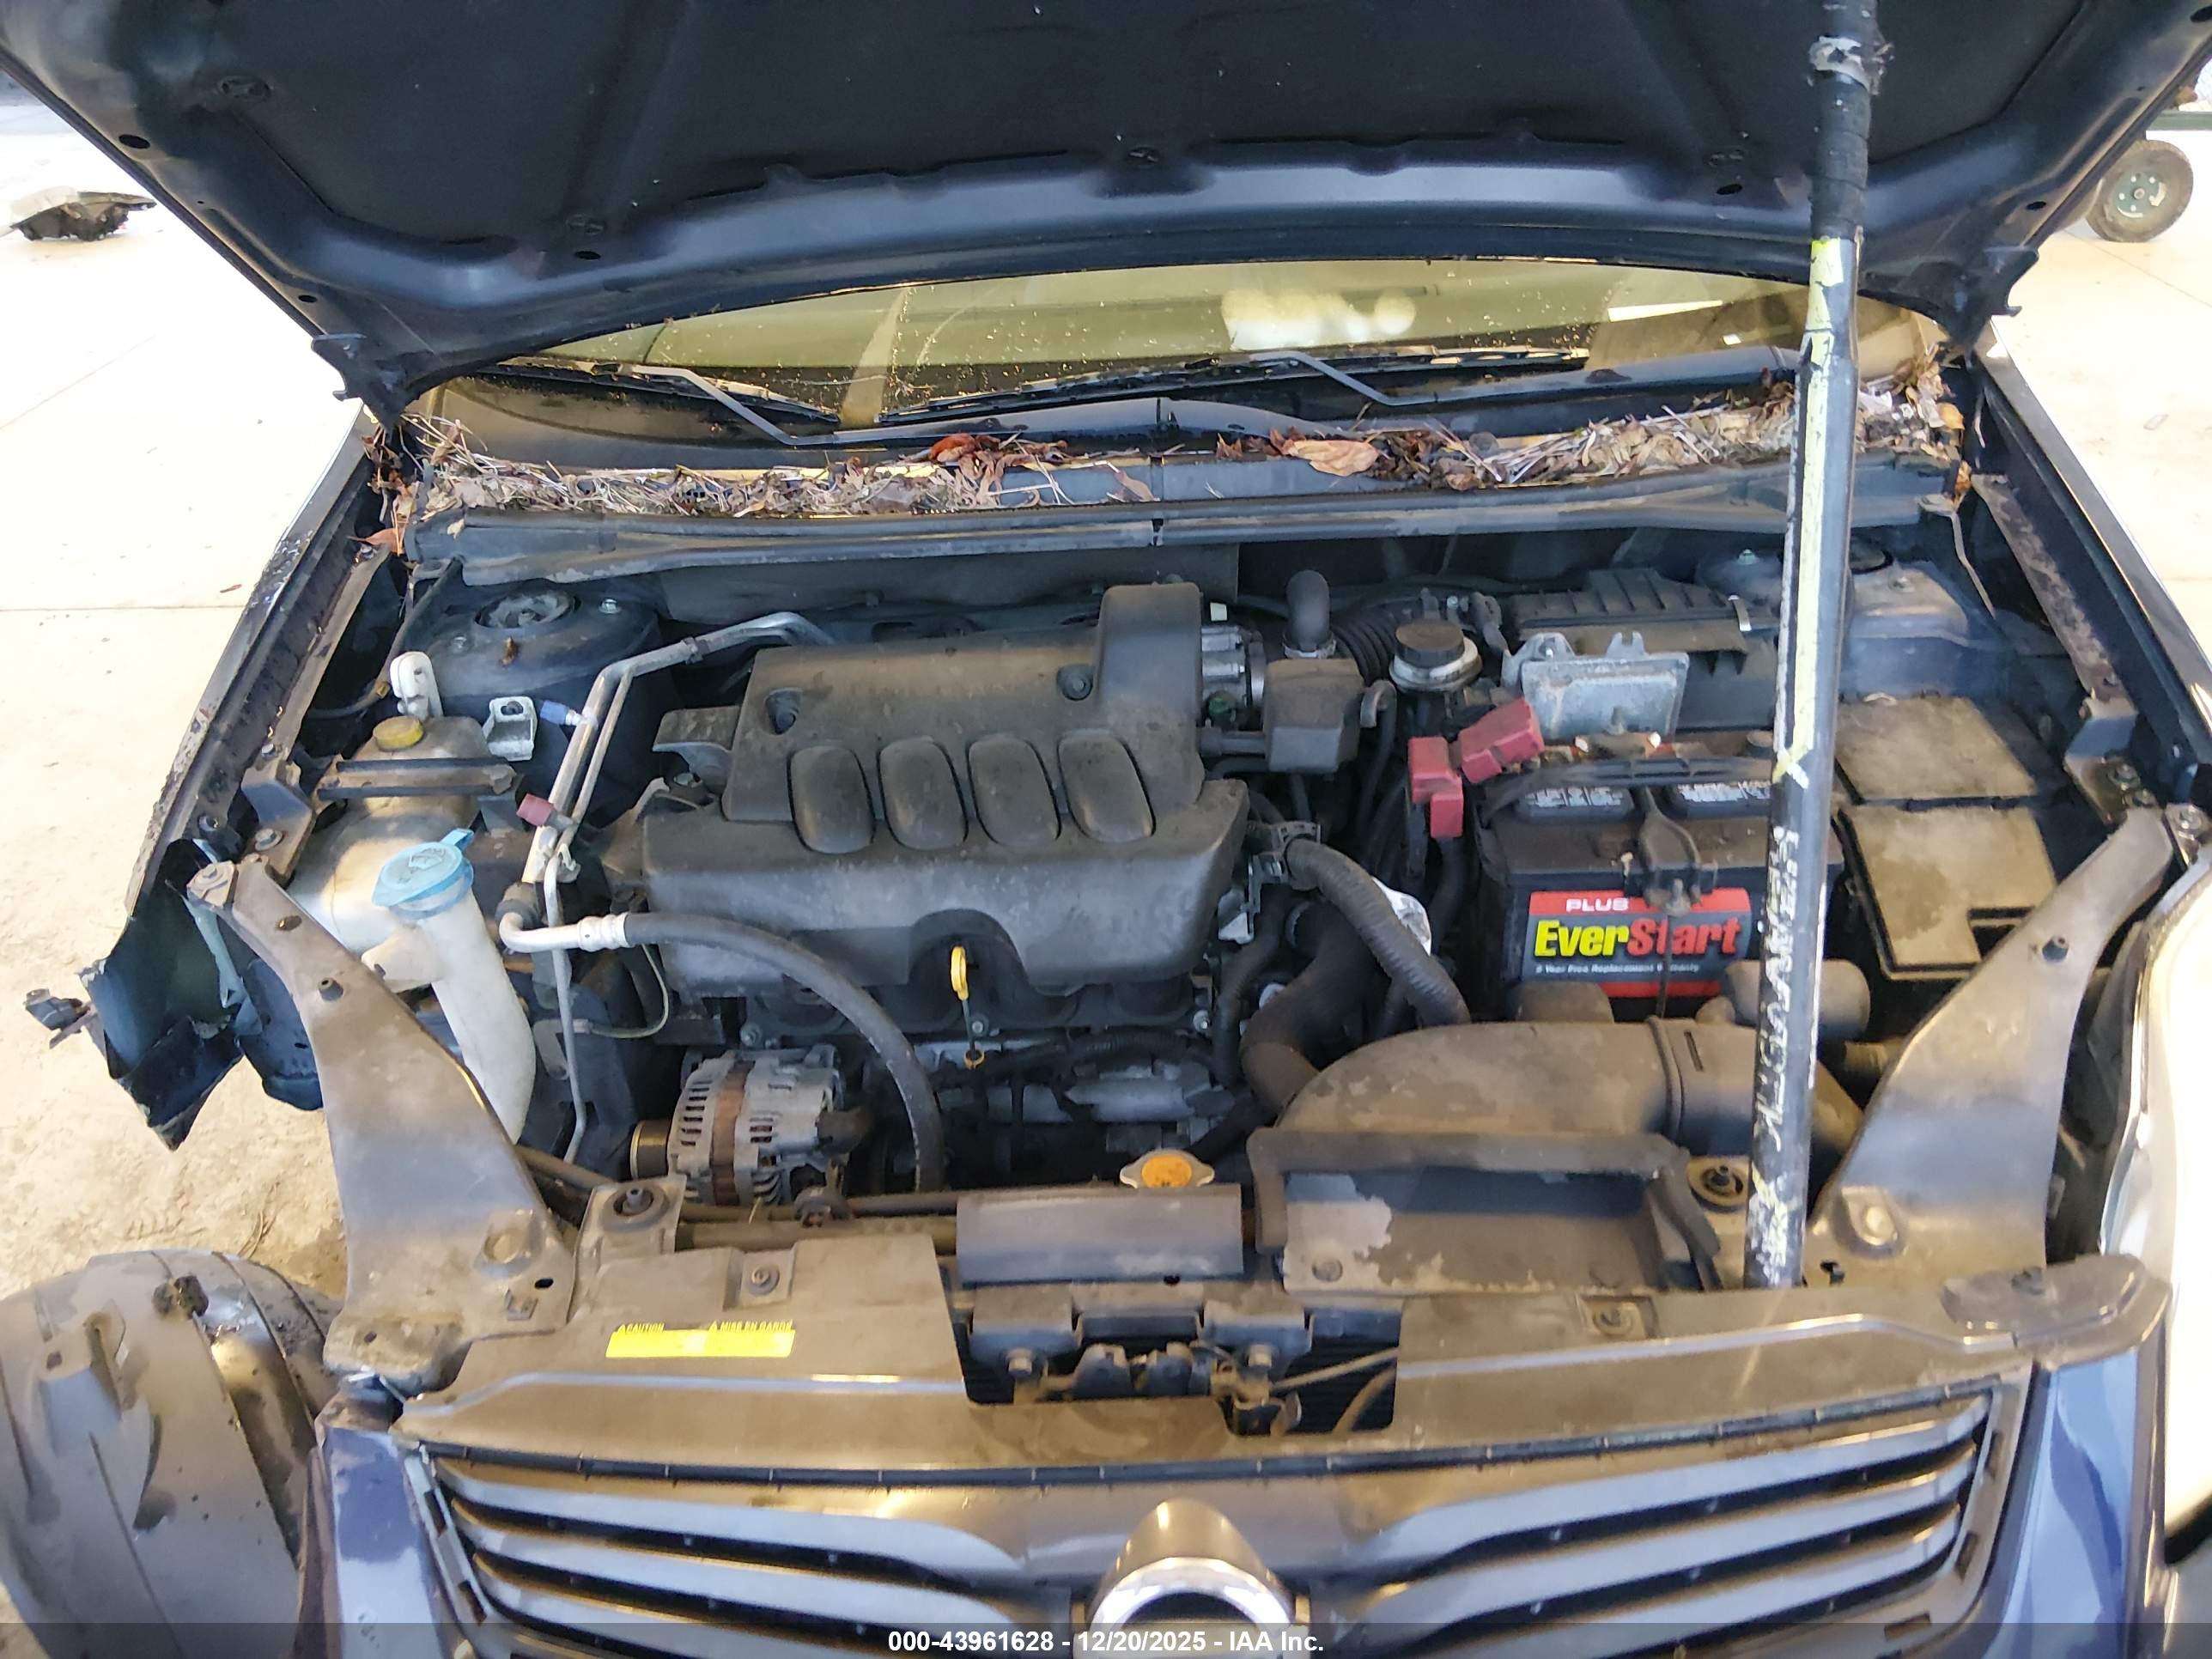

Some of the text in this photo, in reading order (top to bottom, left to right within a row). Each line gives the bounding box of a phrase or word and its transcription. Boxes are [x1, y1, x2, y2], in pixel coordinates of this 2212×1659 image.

[1565, 897, 1629, 912] PLUS
[1534, 916, 1741, 957] EverStart
[1568, 963, 1589, 974] Free
